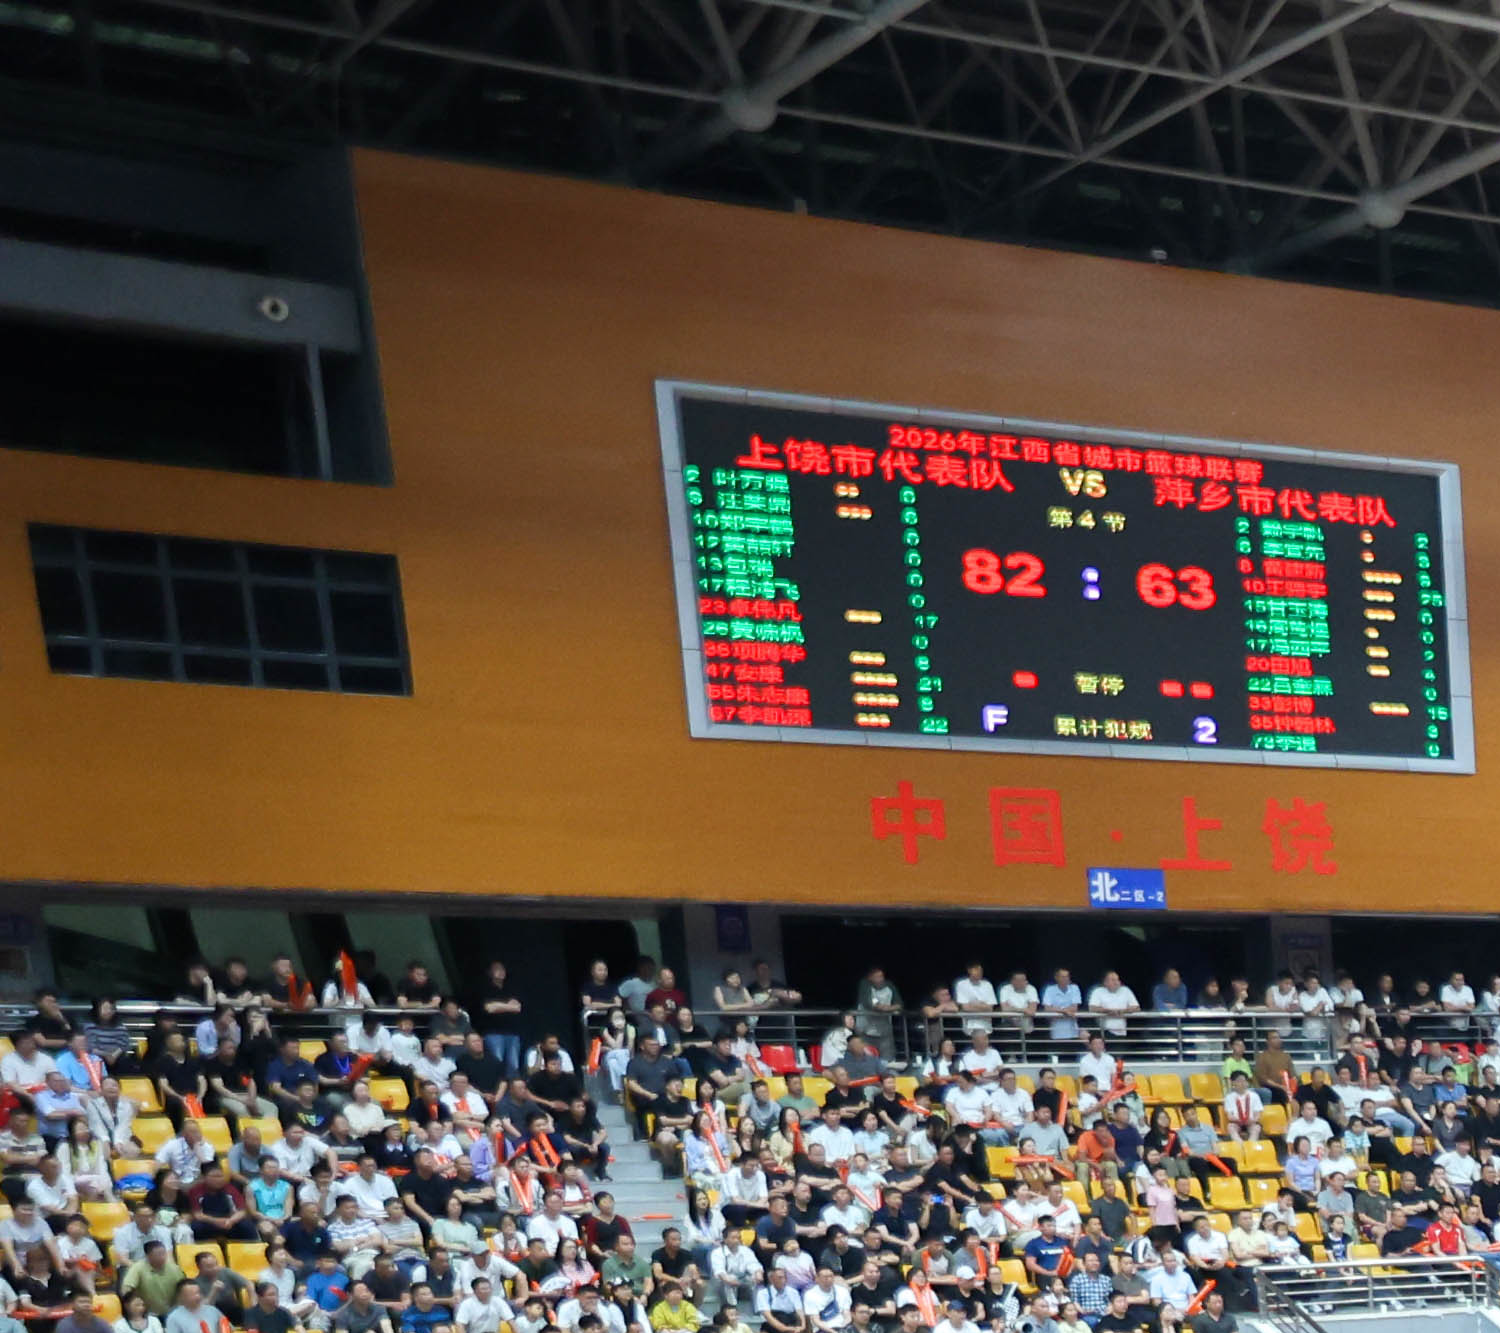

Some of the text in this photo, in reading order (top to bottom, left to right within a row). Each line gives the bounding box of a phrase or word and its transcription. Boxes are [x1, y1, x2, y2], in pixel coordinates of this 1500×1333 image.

[736, 434, 1015, 493] 上饶市代表队
[888, 424, 1263, 484] 2026年江西省城市篮球联赛
[1059, 467, 1107, 497] VS
[1153, 476, 1396, 527] 萍乡市代表队
[962, 548, 1047, 598] 82
[1136, 562, 1217, 610] 63
[706, 662, 733, 679] 47
[1074, 671, 1124, 696] 暂停
[1247, 676, 1271, 692] 22
[982, 704, 1009, 733] F
[1054, 714, 1153, 741] 累计犯规
[1192, 716, 1218, 744] 2
